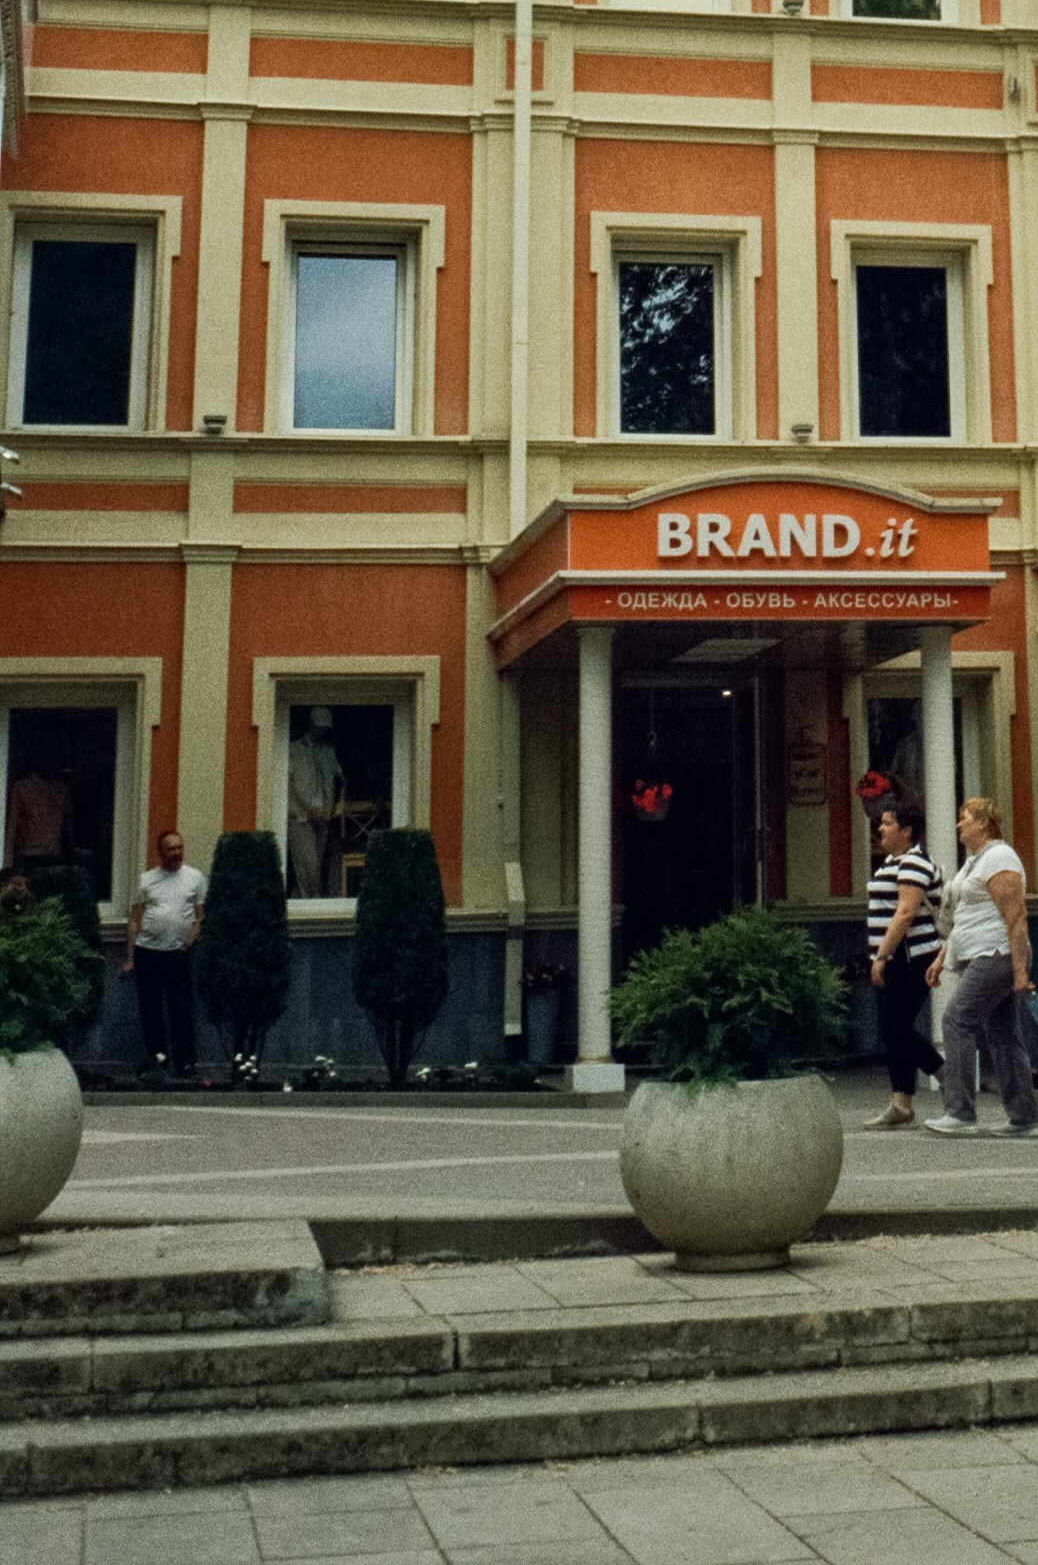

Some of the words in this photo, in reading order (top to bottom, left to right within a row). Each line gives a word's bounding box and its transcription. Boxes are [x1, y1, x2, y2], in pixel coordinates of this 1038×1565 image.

[656, 511, 919, 559] BRAND.it
[616, 591, 708, 612] ОДЕЖДА
[725, 591, 797, 610] ОБУВЬ
